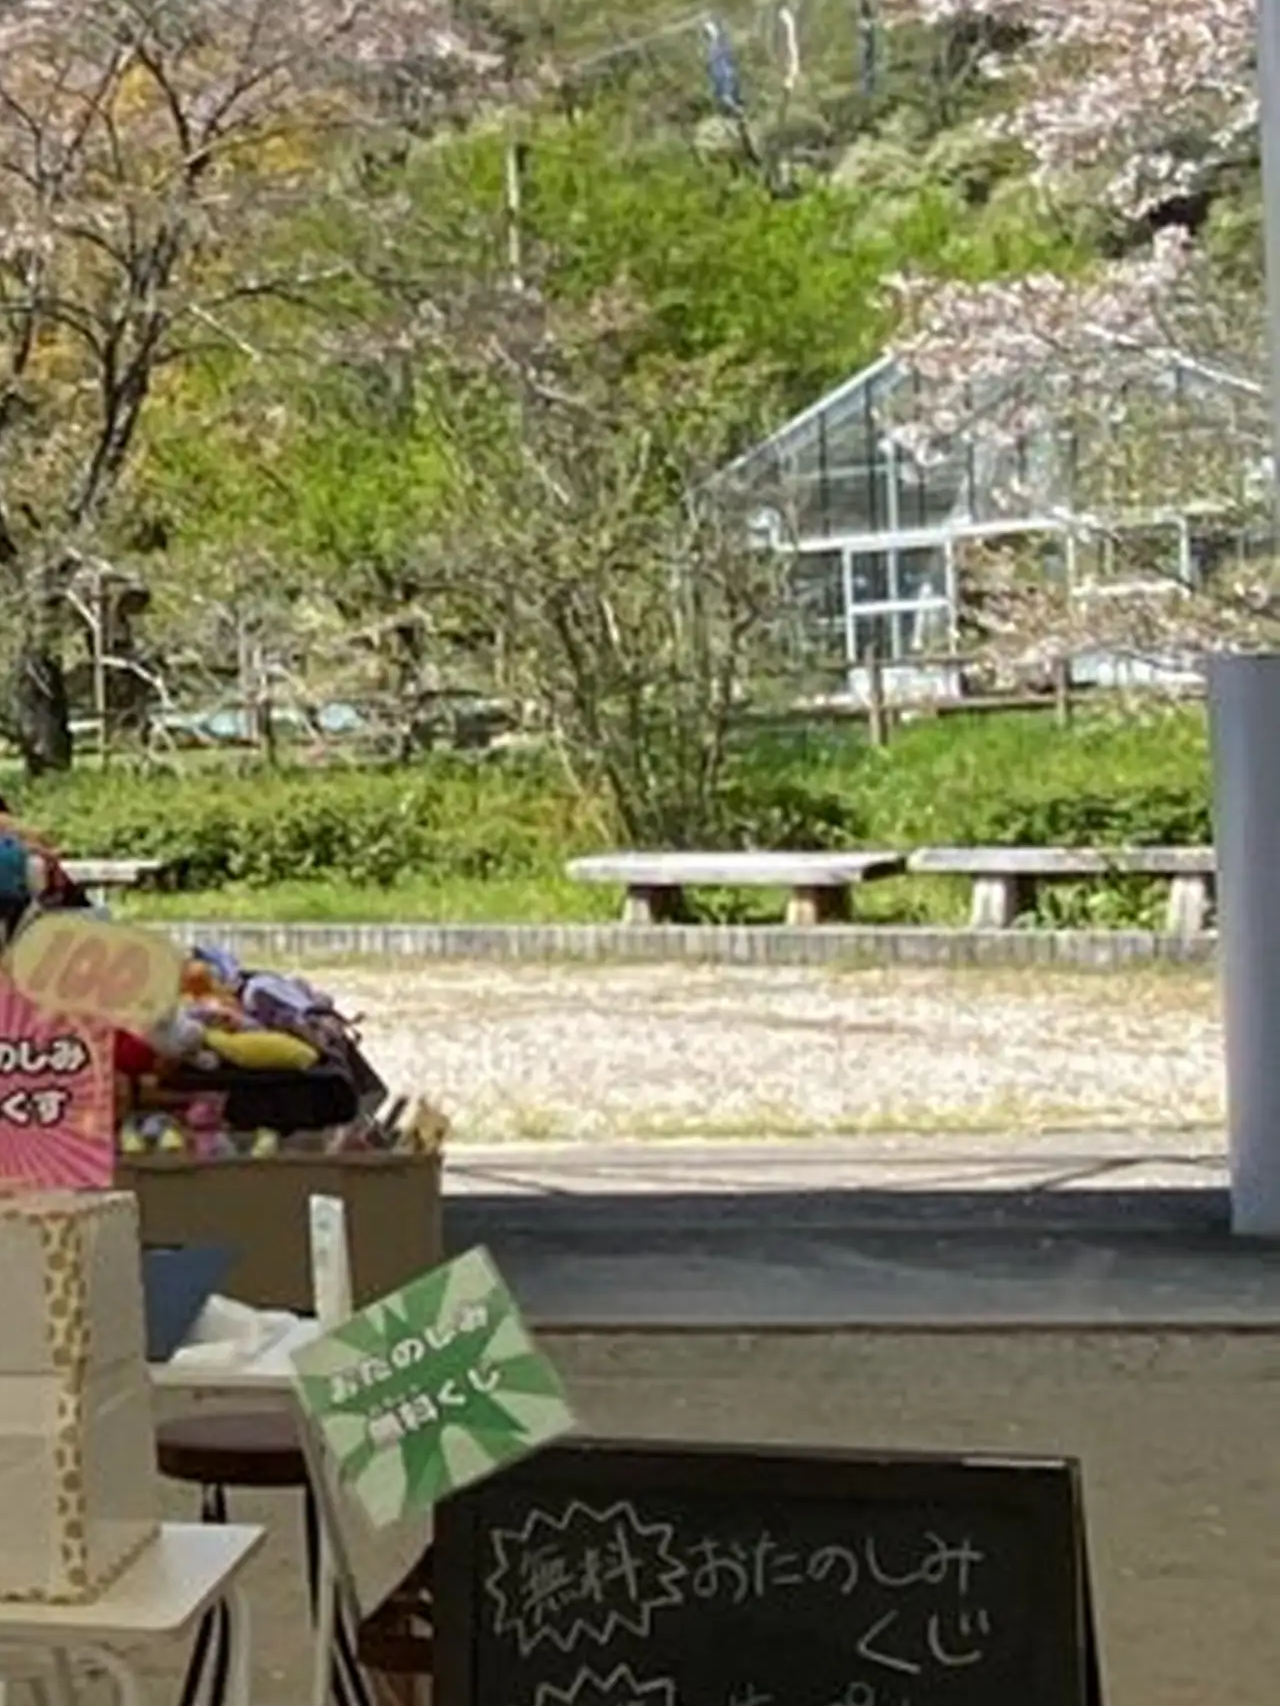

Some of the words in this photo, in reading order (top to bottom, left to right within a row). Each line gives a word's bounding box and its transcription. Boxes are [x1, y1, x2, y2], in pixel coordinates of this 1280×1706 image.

[330, 1301, 490, 1405] おたのしみ
[518, 1522, 640, 1612] 無料
[693, 1533, 984, 1603] おたのしみ
[856, 1609, 991, 1675] くじ
